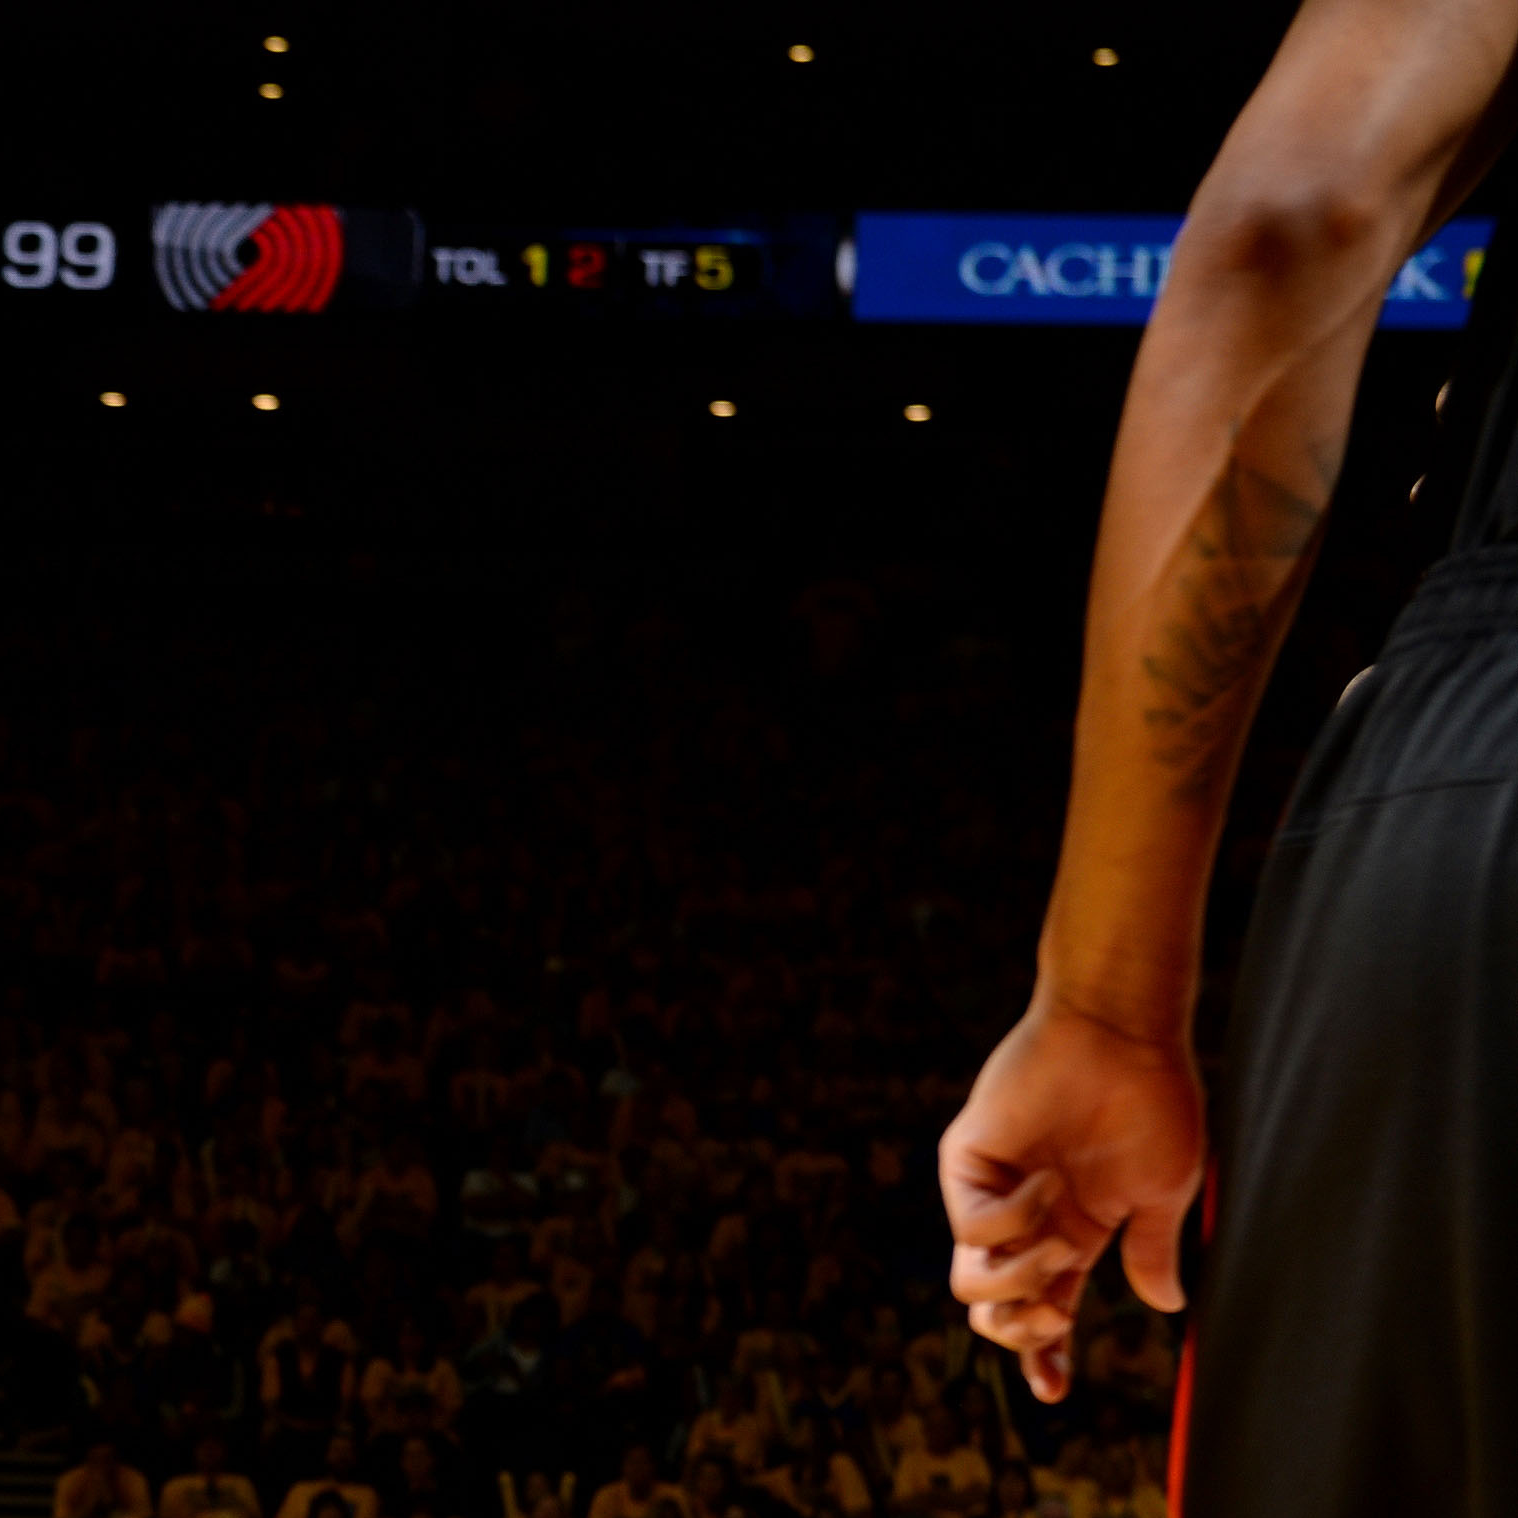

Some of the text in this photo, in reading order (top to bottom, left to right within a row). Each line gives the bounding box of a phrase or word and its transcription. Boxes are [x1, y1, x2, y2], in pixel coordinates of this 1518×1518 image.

[2, 219, 116, 291] 99
[431, 246, 508, 286] TOL
[522, 243, 549, 288] 1
[639, 248, 691, 288] TF
[695, 244, 734, 290] 5
